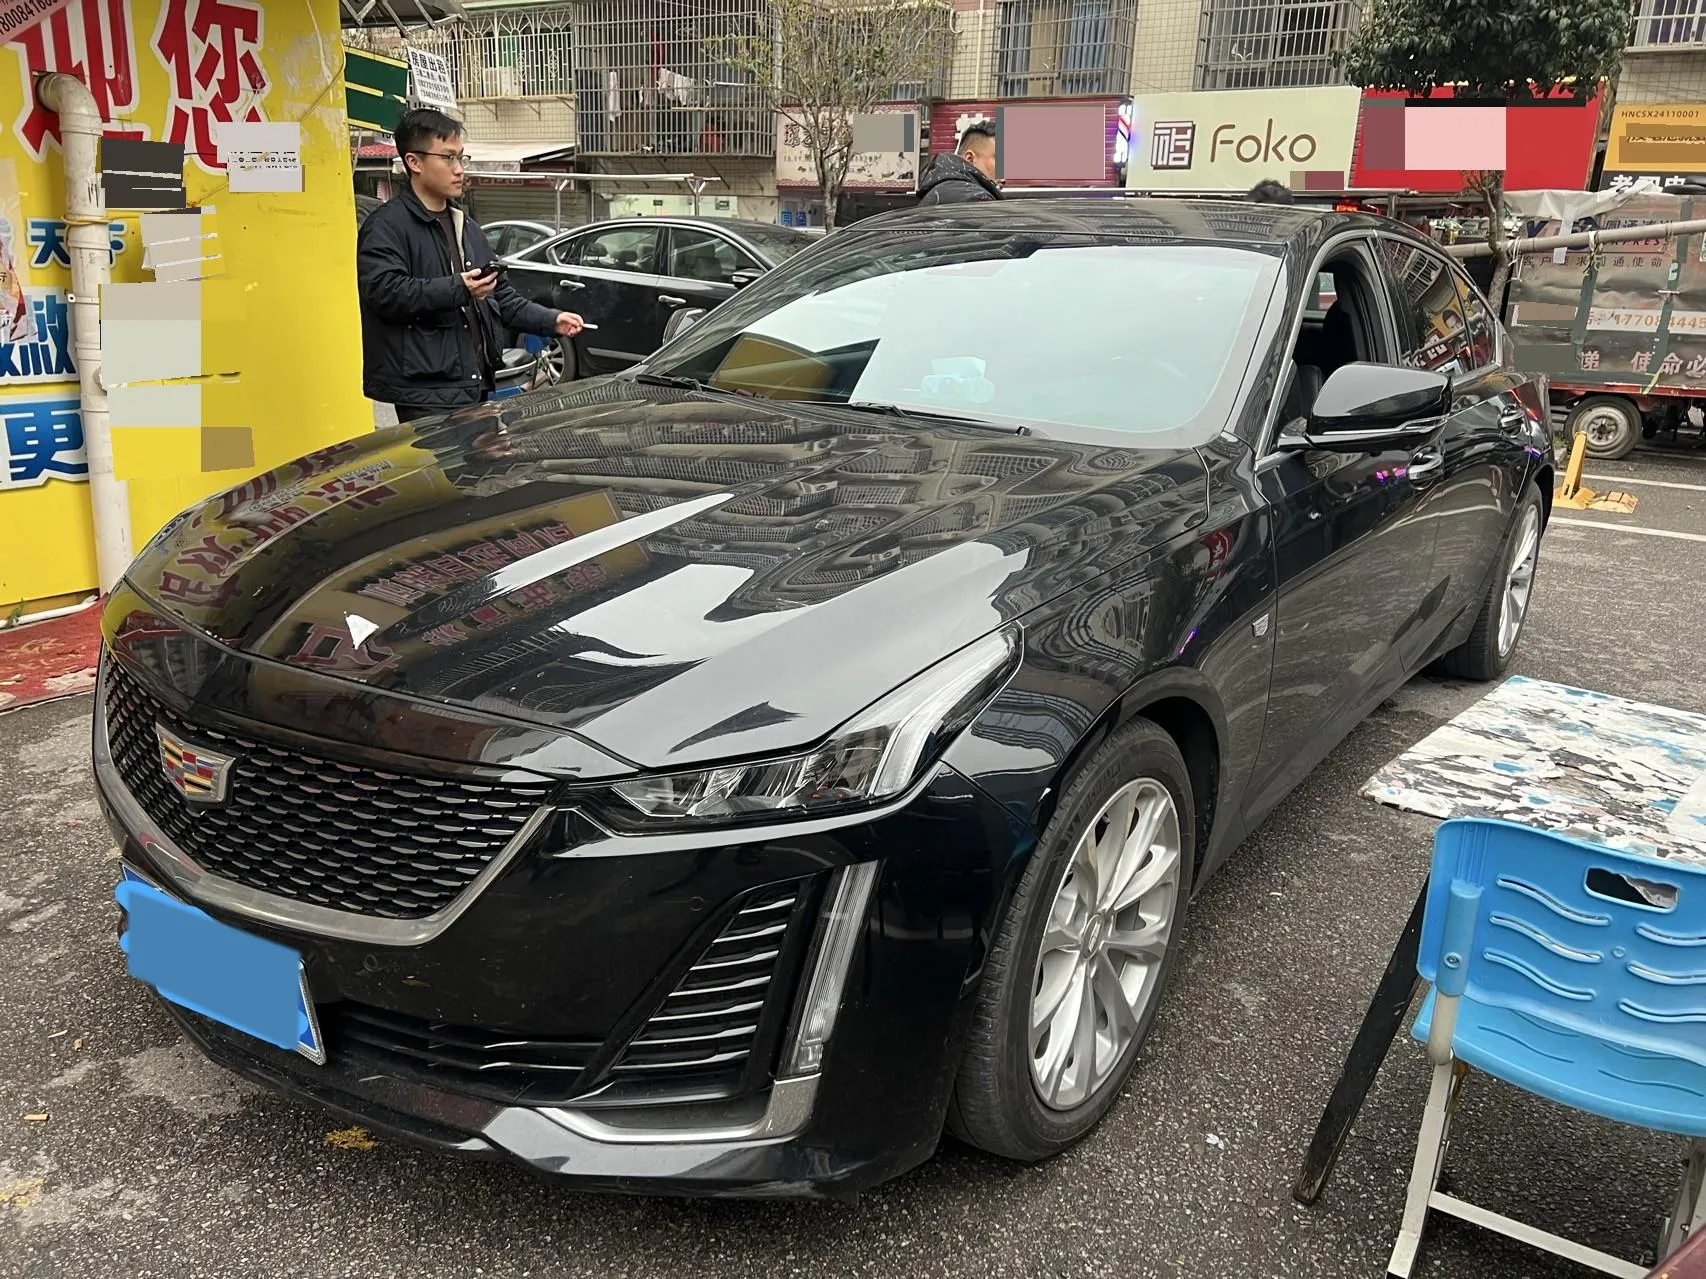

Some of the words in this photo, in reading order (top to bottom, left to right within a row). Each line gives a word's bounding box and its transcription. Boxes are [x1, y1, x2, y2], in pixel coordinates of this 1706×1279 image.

[411, 51, 447, 75] 房屋出租
[1621, 110, 1699, 118] HNCSX24110001
[1210, 118, 1317, 163] Foko
